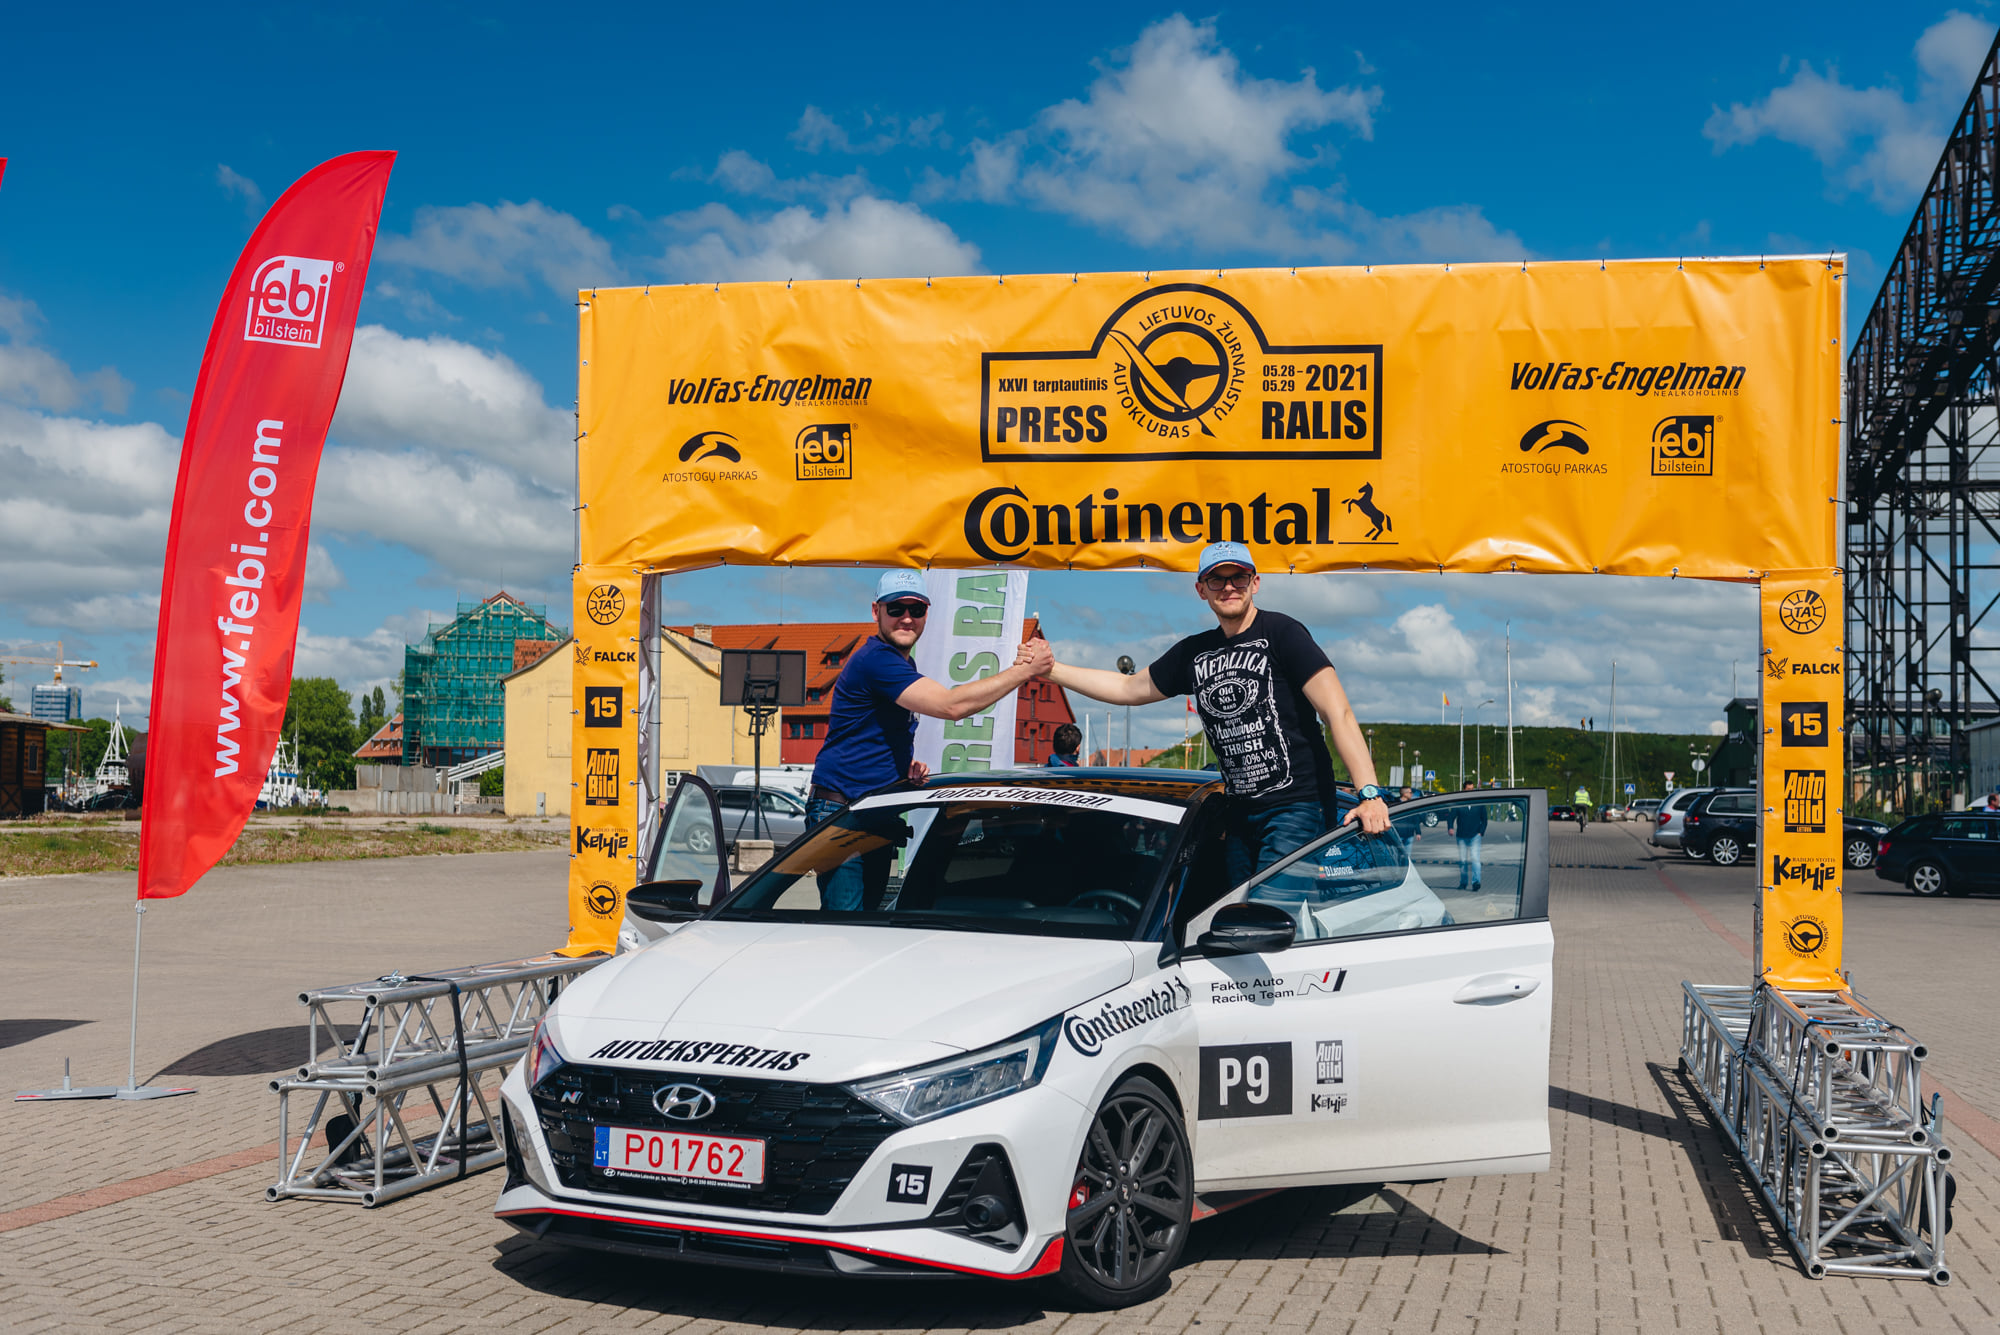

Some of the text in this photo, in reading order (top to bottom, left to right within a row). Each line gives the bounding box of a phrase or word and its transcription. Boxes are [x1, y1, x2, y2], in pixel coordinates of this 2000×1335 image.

[250, 259, 329, 319] febi
[254, 317, 312, 341] bilstein
[1139, 305, 1246, 421] LIETUVOS ŽURNALISTŲ
[998, 377, 1108, 394] XXVI tarptautinis
[1262, 379, 1295, 392] 05.29
[1305, 364, 1367, 391] 2021
[1113, 362, 1190, 438] AUTOKLUBAS
[996, 404, 1107, 444] PRESS
[1261, 400, 1367, 440] RALIS
[795, 426, 850, 465] febi
[1651, 417, 1713, 458] febi
[662, 470, 758, 484] ATOSTOGŲ PARKAS
[803, 465, 845, 478] bilstein
[1501, 463, 1608, 476] ATOSTOGŲ PARKAS
[1658, 459, 1705, 473] bilstein
[964, 484, 1334, 562] Continental
[214, 418, 284, 779] www.febi.com
[594, 651, 636, 662] FALCK
[1792, 663, 1841, 674] FALCK
[1194, 651, 1268, 687] METALLICA
[1218, 685, 1234, 697] Old
[590, 696, 617, 718] 15
[1787, 712, 1823, 736] 15
[587, 750, 619, 775] Auto
[588, 775, 617, 798] Bild
[1785, 771, 1825, 800] Auto
[1787, 799, 1824, 824] Bild
[1211, 977, 1284, 992] Fakto Auto
[1212, 989, 1294, 1004] Racing Team
[1064, 981, 1179, 1057] Continental
[589, 1039, 811, 1071] AUTOEKSPERTAS
[1316, 1042, 1342, 1062] Auto
[1218, 1055, 1270, 1106] P9
[596, 1150, 608, 1161] LT
[625, 1133, 745, 1177] P01762
[895, 1173, 926, 1195] 15
